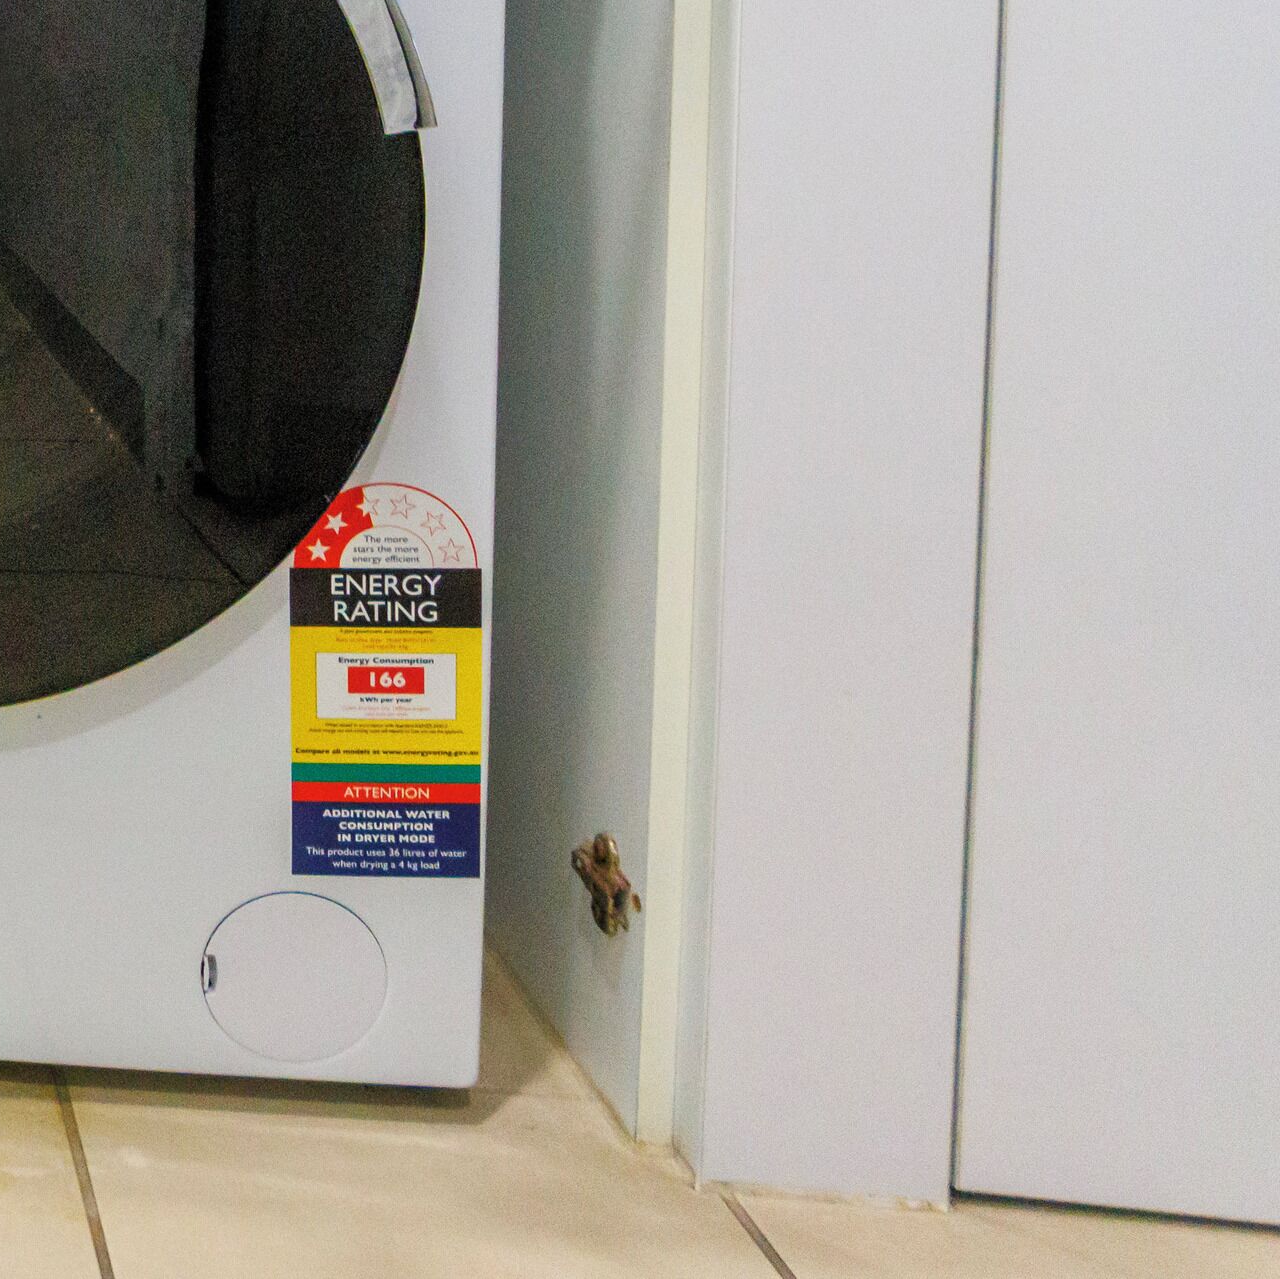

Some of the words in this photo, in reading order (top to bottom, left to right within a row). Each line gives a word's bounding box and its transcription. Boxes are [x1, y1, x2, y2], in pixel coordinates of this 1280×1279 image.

[364, 535, 382, 544] The
[384, 536, 409, 544] more
[353, 545, 374, 553] stars
[377, 545, 392, 553] the
[394, 546, 419, 554] more
[352, 556, 382, 566] energy
[385, 554, 420, 564] efficient
[330, 574, 442, 596] ENERGY
[333, 600, 438, 622] RATING
[338, 656, 370, 665] Energy
[372, 657, 434, 665] Consumption
[369, 672, 407, 688] 166
[295, 747, 329, 756] Compare
[344, 786, 430, 799] ATTENTION
[323, 809, 402, 819] ADDITIONAL
[405, 810, 450, 819] WATER
[338, 821, 434, 831] CONSUMPTION
[337, 834, 351, 842] IN
[355, 834, 395, 843] DRYER
[399, 835, 435, 843] MODE
[306, 846, 325, 855] This
[327, 847, 363, 857] product
[402, 848, 425, 857] litres
[428, 848, 438, 857] of
[439, 850, 467, 858] water
[332, 860, 357, 868] when
[360, 860, 388, 870] drying
[398, 860, 404, 869] 4
[407, 860, 418, 871] kg
[420, 860, 440, 870] load
